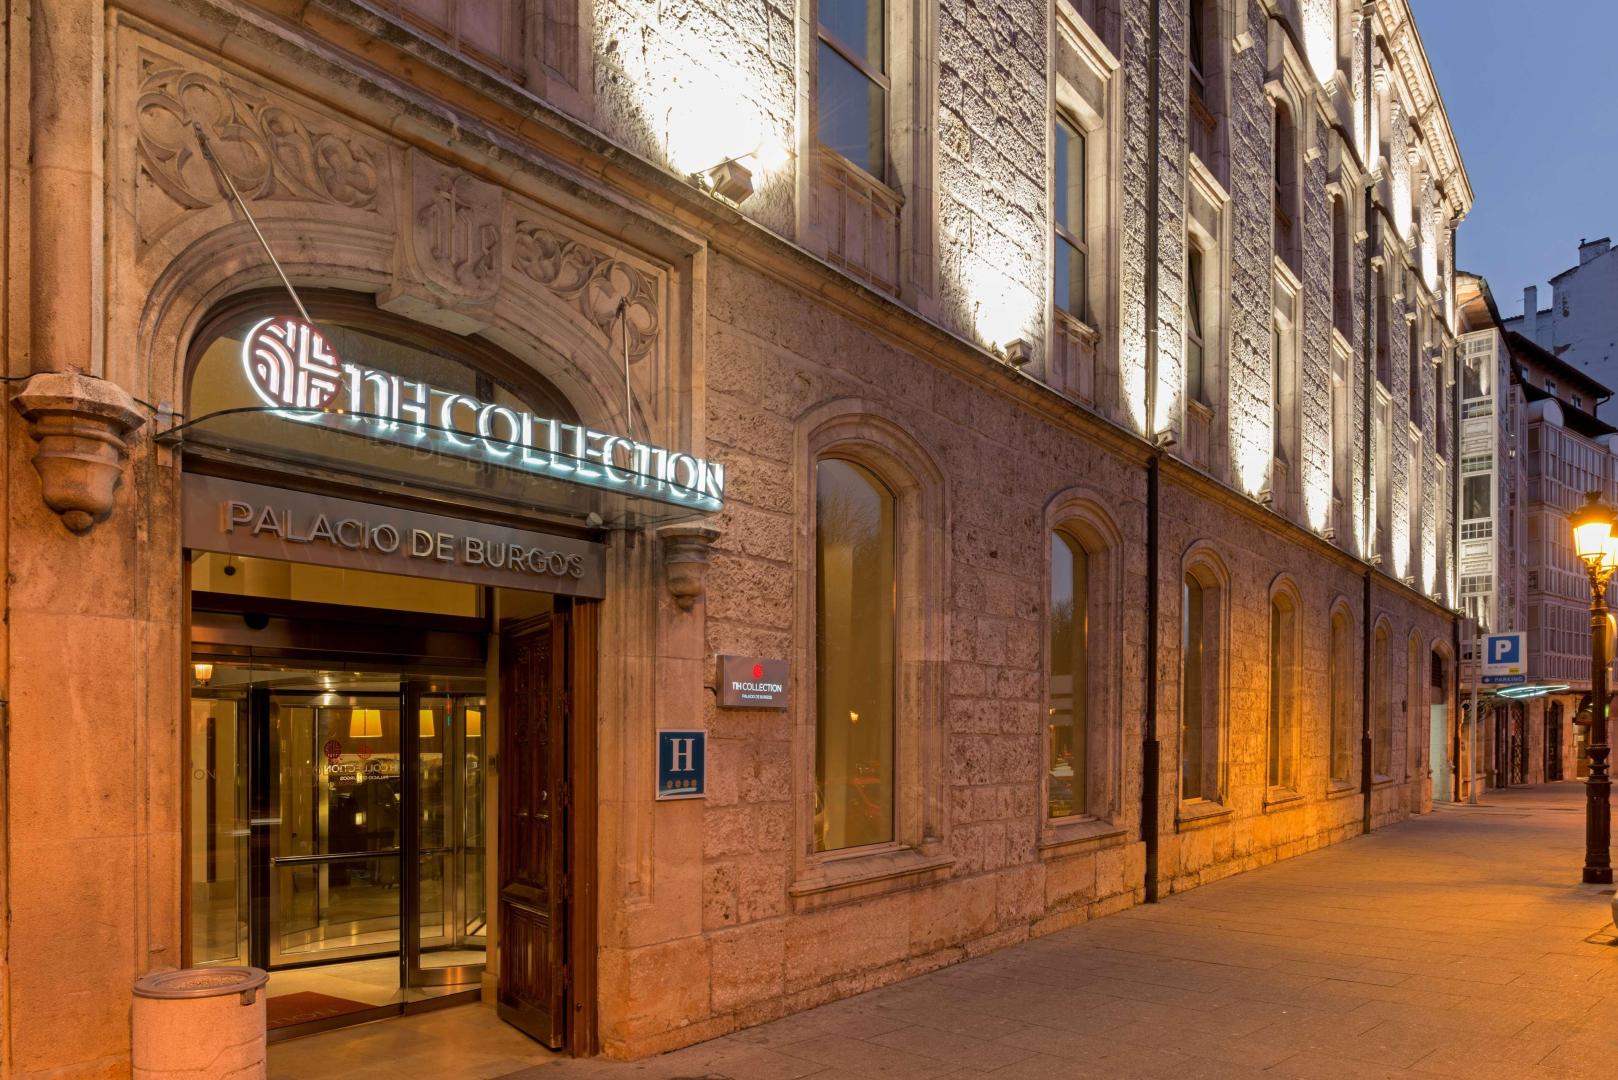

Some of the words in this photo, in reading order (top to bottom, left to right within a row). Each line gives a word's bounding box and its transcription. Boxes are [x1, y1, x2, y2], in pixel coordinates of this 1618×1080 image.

[441, 394, 725, 500] COLLECTION
[224, 503, 400, 553] PALACIO
[412, 529, 454, 563] DE
[464, 536, 584, 579] BURGOS
[1495, 640, 1512, 660] P
[743, 682, 782, 692] COLLECTION
[669, 738, 695, 771] H
